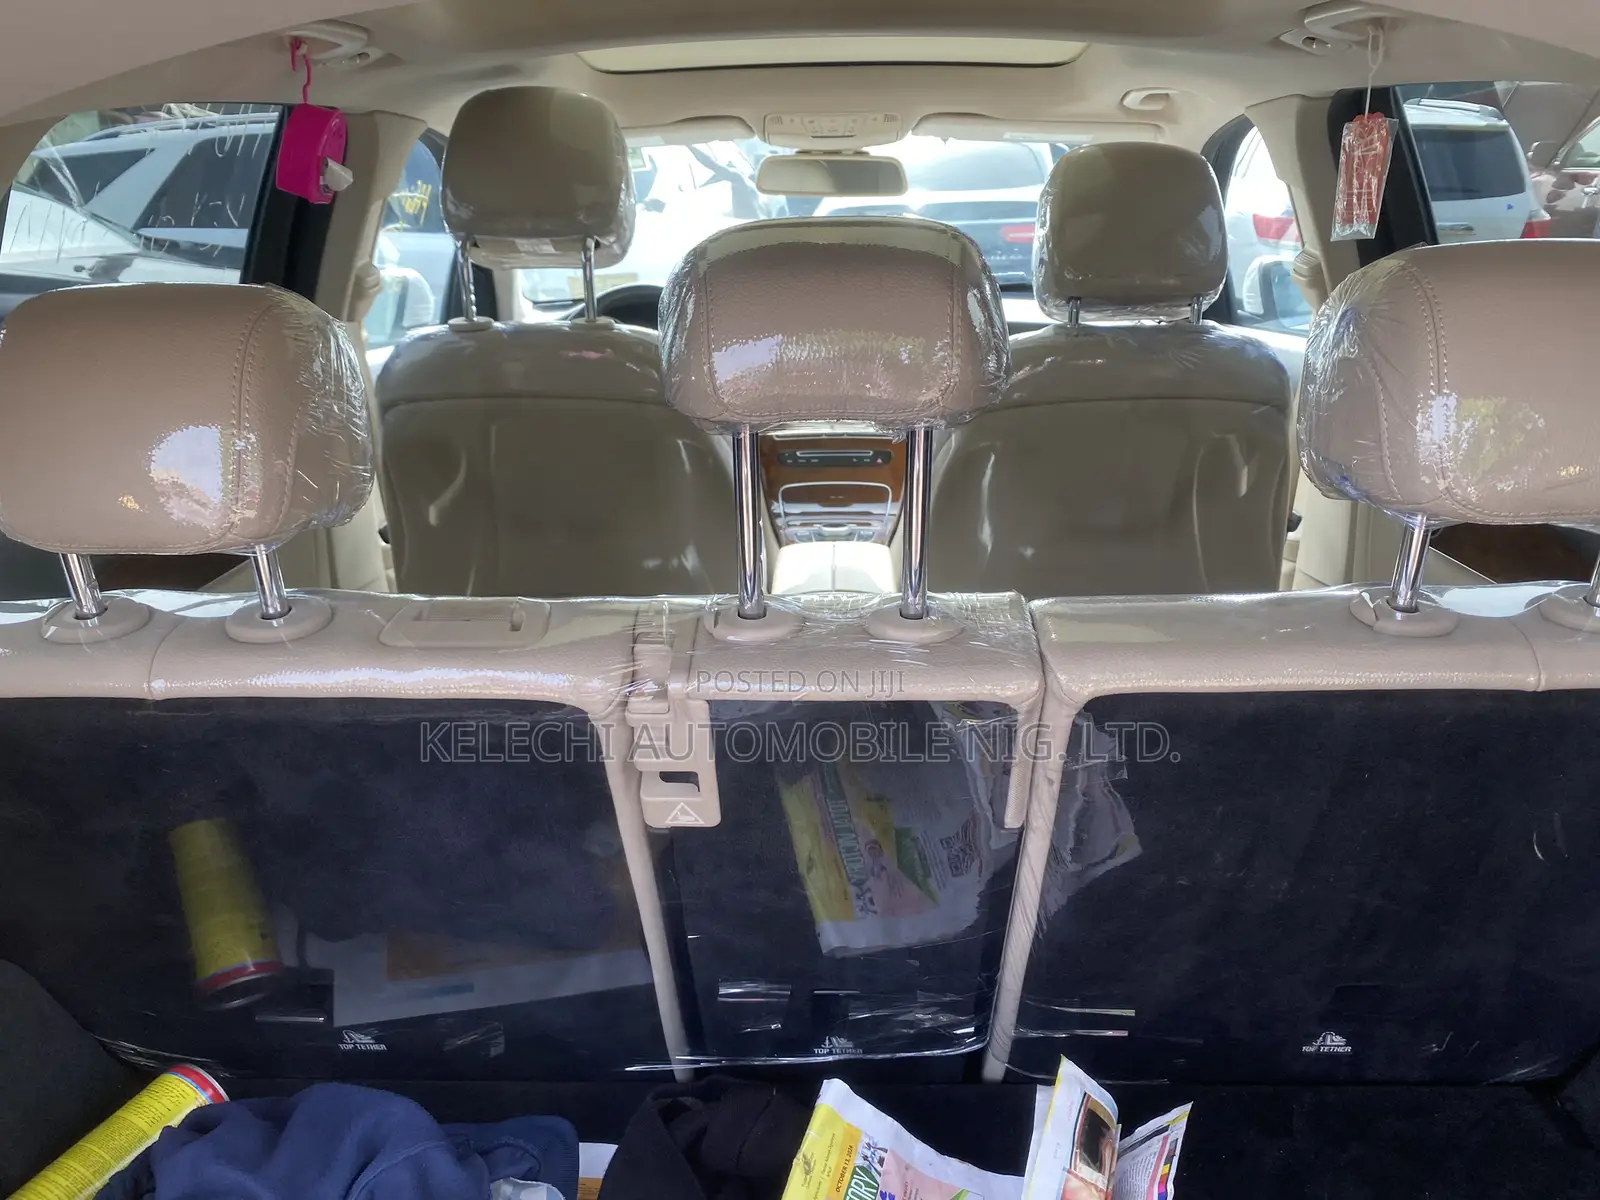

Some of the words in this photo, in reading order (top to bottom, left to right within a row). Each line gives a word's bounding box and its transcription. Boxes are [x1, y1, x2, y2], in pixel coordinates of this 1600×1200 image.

[355, 1043, 388, 1051] TETHER
[835, 1165, 848, 1193] OCTOBER
[845, 1166, 879, 1200] ORY
